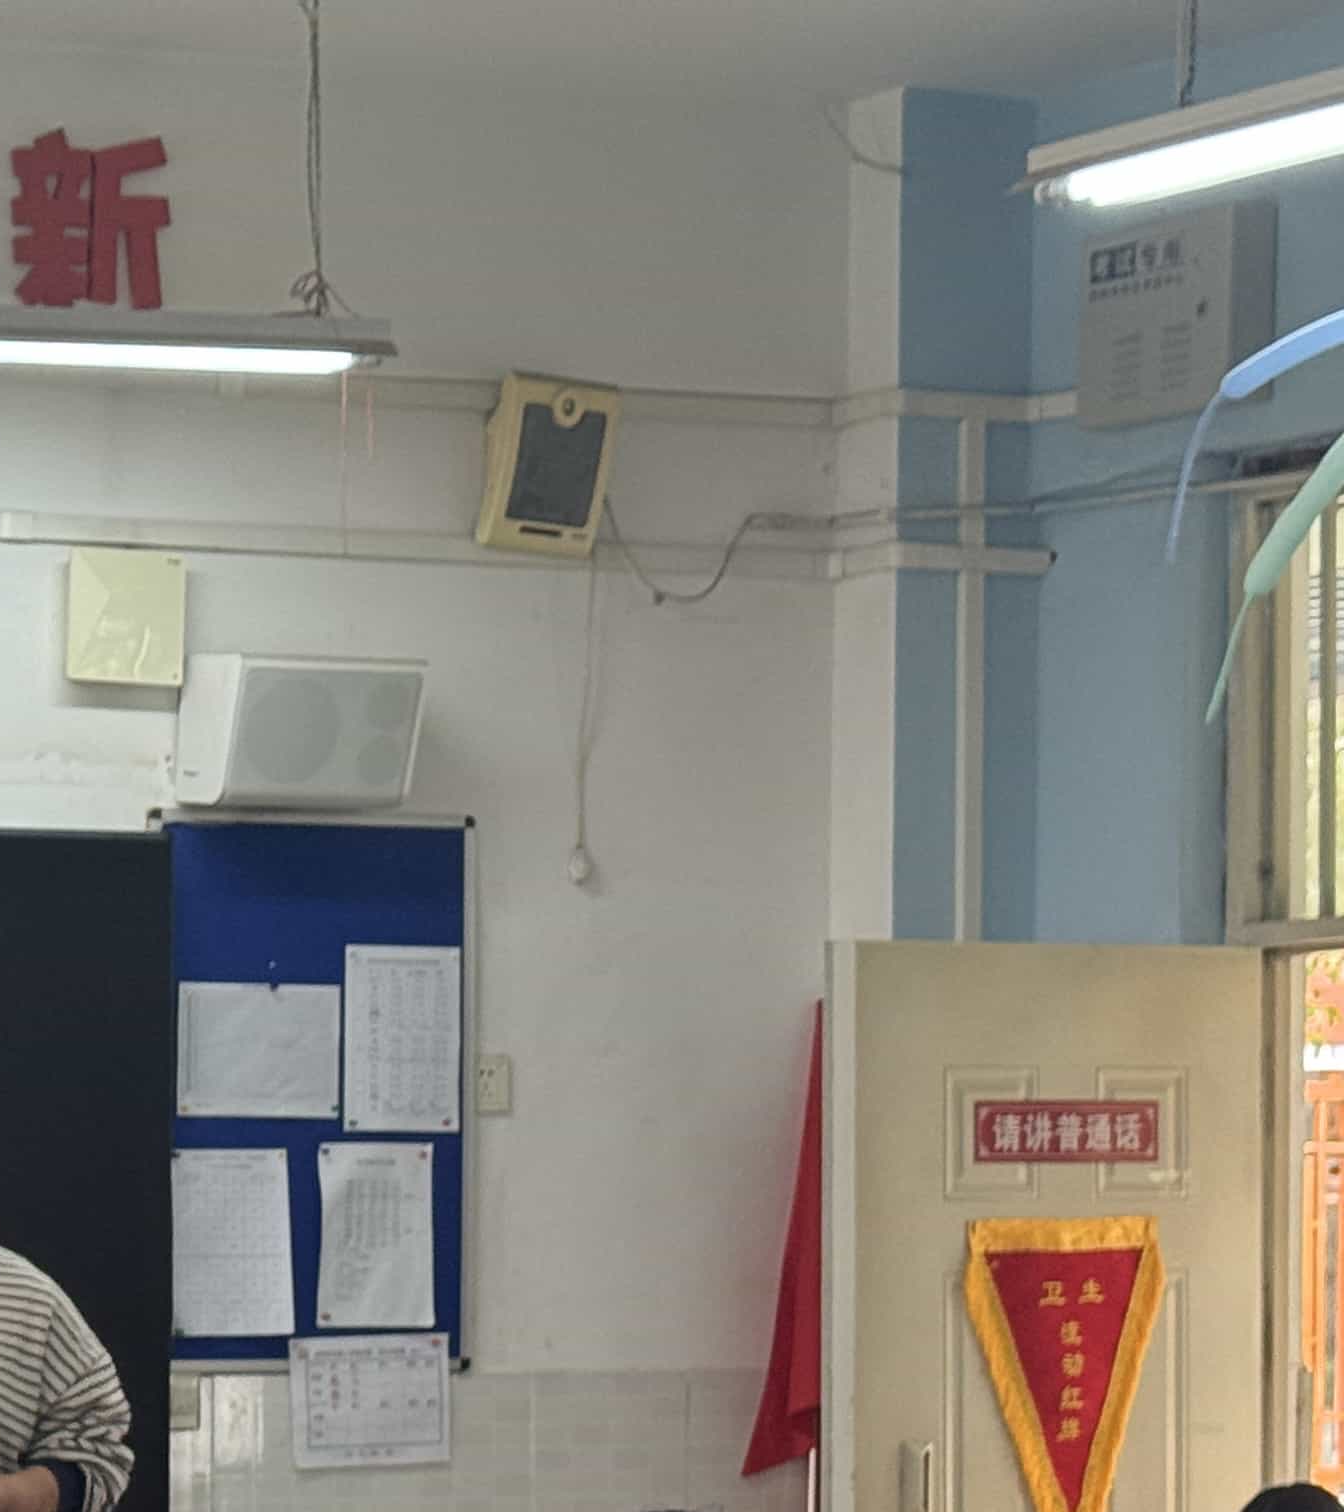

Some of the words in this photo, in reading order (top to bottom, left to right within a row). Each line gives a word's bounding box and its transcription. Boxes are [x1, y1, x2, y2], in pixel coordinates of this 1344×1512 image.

[993, 1111, 1144, 1153] 请讲普通话
[1039, 1279, 1105, 1307] 卫生
